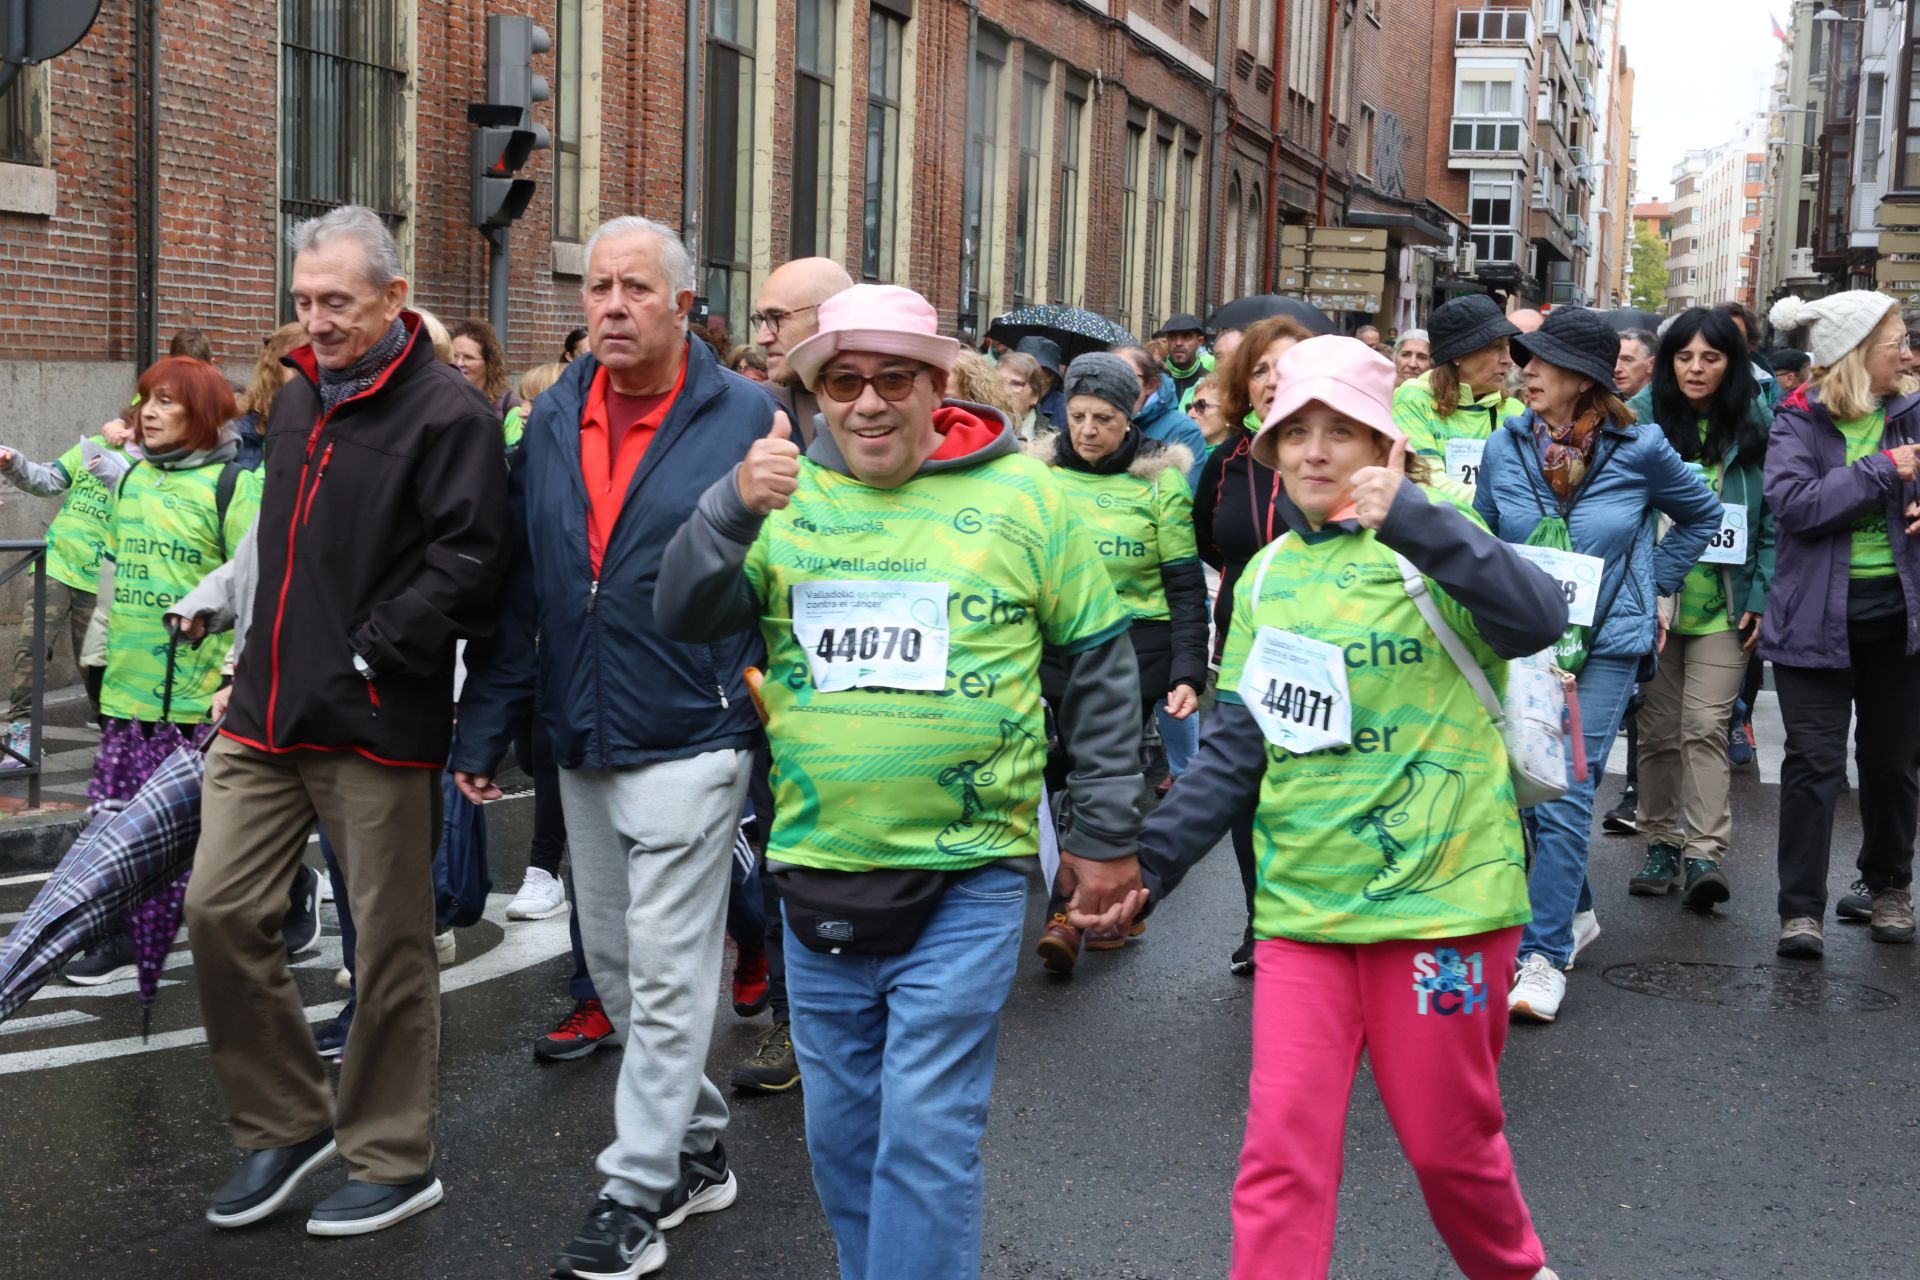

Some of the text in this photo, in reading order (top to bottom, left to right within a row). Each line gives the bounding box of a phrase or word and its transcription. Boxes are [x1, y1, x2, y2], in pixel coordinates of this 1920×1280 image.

[75, 486, 108, 504] ntra
[124, 537, 203, 566] marcha
[1094, 536, 1146, 557] cha
[114, 558, 149, 580] ntra
[829, 556, 927, 573] Valladolid
[1560, 580, 1578, 604] 8
[948, 589, 1027, 626] rcha
[816, 626, 922, 664] 44070
[787, 661, 816, 690] e
[1261, 678, 1334, 731] 44071
